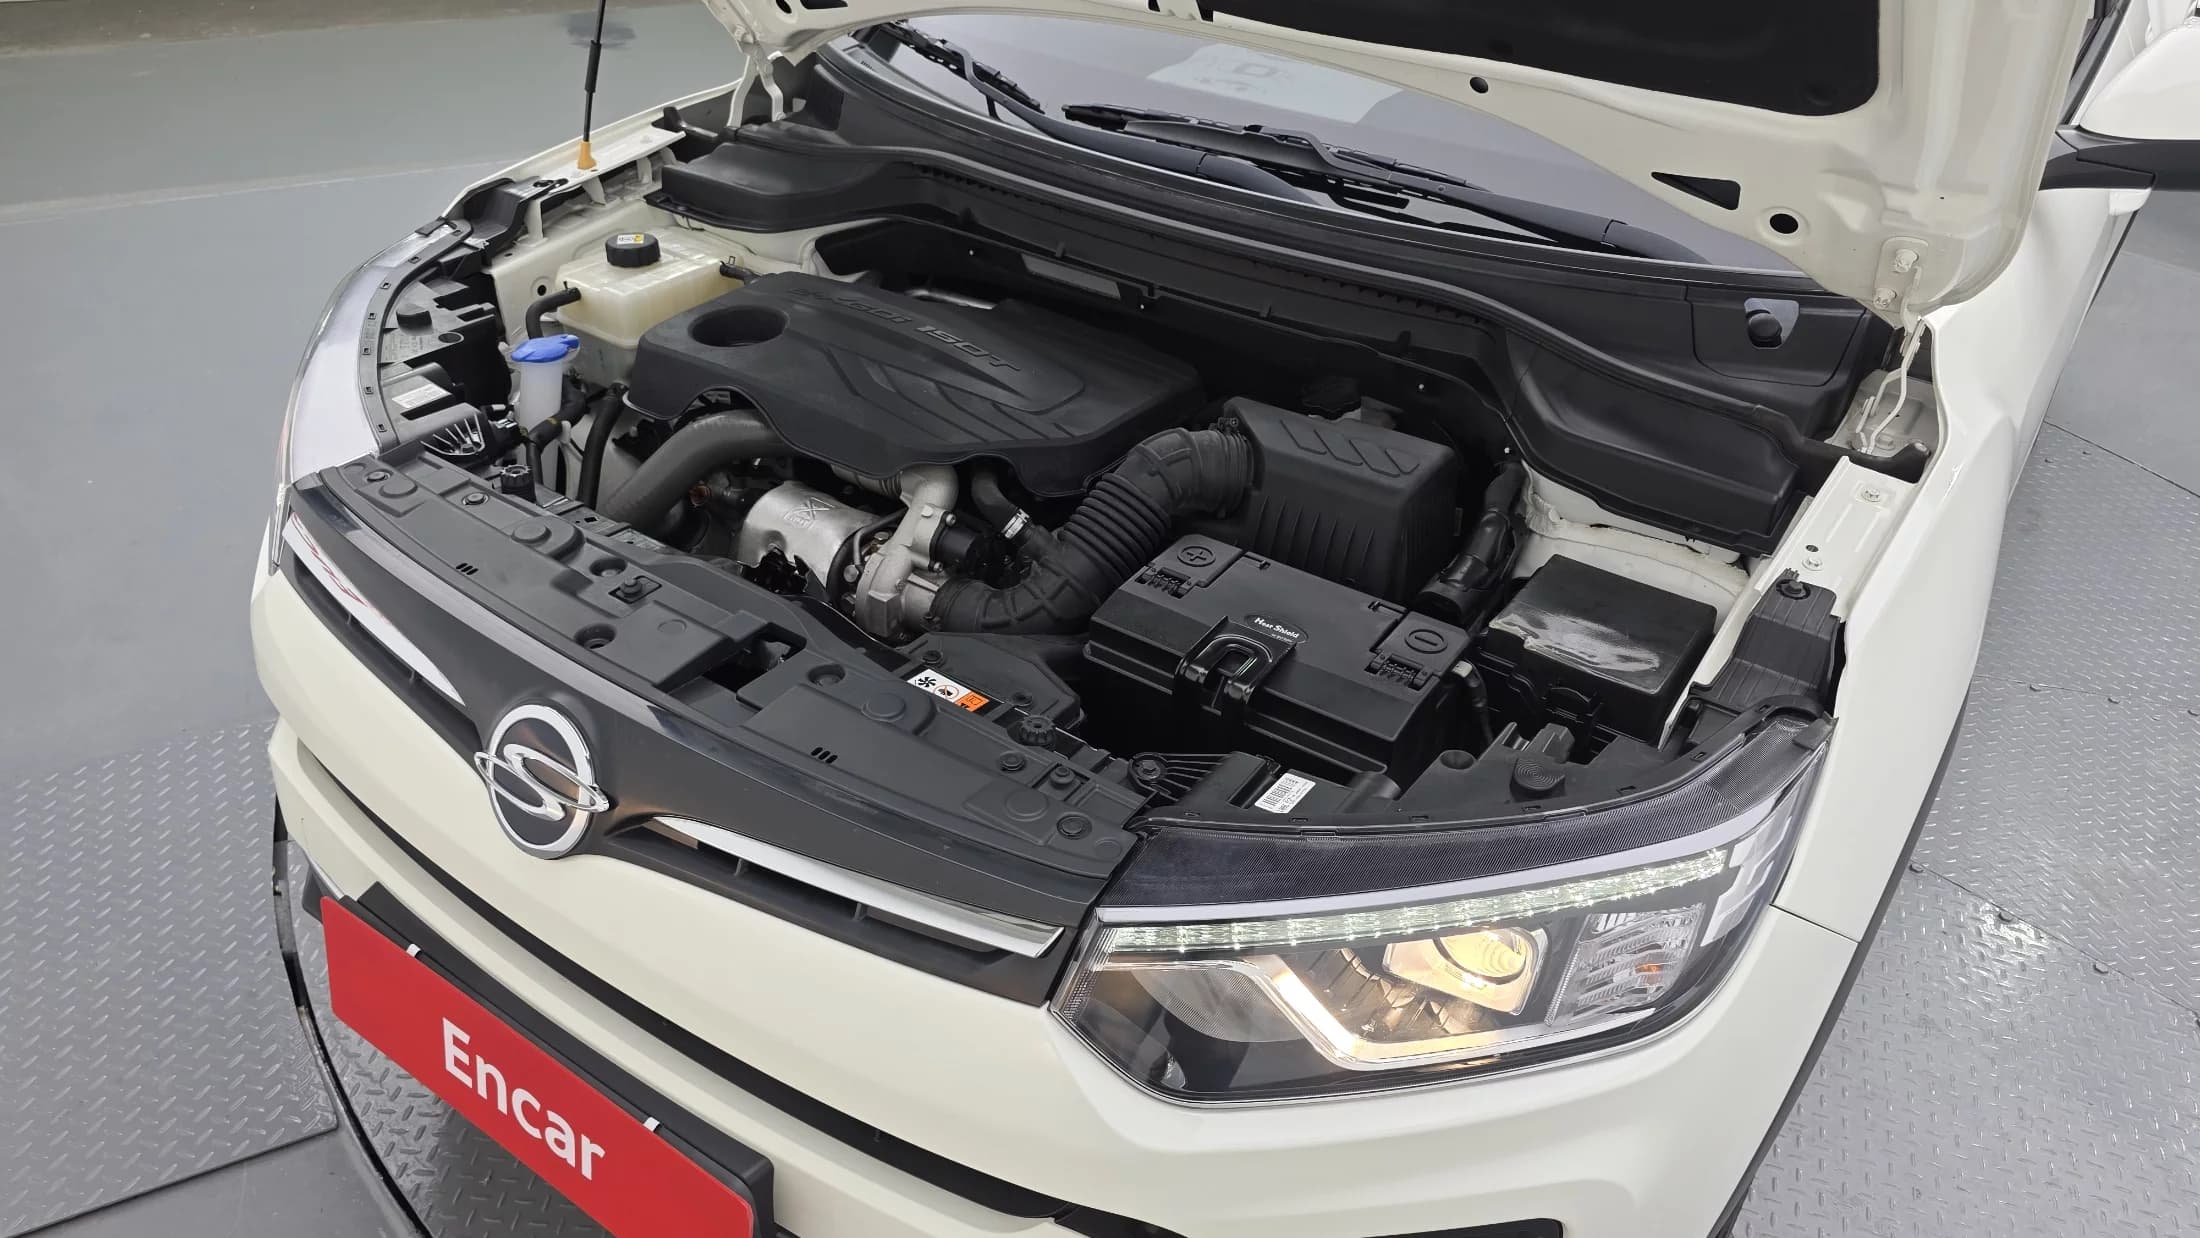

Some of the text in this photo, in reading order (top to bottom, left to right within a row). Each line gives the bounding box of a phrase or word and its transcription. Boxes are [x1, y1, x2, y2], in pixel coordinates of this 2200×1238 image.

[915, 324, 1022, 372] 150T
[1273, 625, 1300, 639] Shield
[442, 1017, 606, 1181] Encar
